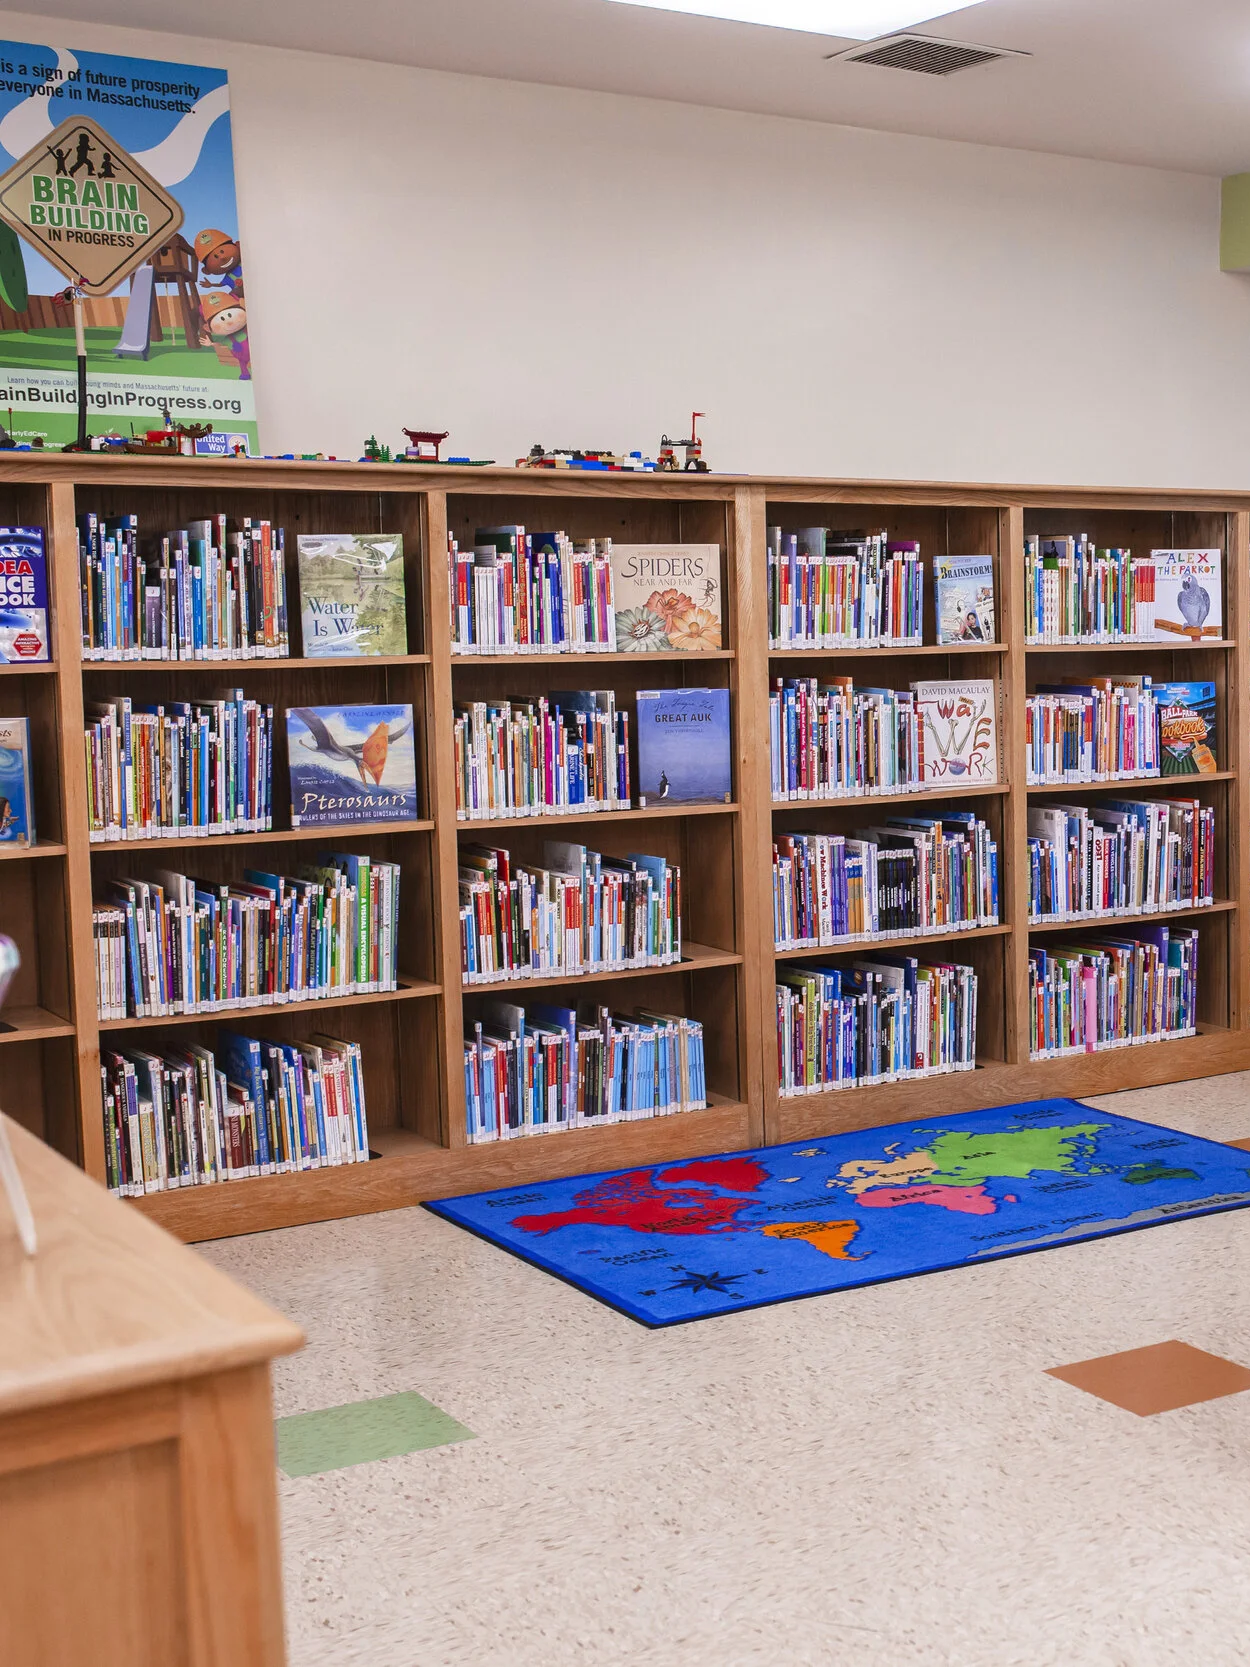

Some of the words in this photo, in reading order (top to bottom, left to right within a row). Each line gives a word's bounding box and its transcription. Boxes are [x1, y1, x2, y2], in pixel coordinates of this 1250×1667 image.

[1, 60, 14, 74] is
[18, 65, 28, 75] a
[32, 64, 63, 82] sign
[67, 70, 82, 83] of
[85, 73, 127, 88] future
[131, 78, 200, 100] prosperity
[69, 85, 82, 100] in
[87, 88, 197, 114] Massachusetts.
[32, 174, 140, 212] BRAIN
[29, 203, 151, 236] BUILDING
[48, 229, 62, 242] IN
[66, 231, 135, 248] PROGRESS
[0, 386, 241, 414] ainBuildngInProgress.org
[208, 443, 226, 453] Way
[1166, 552, 1209, 564] ALEX
[621, 556, 703, 578] SPIDERS
[940, 565, 993, 579] BRAINSTORM!
[1158, 566, 1177, 575] THE
[1179, 565, 1216, 575] PARROT
[306, 597, 358, 615] Water
[313, 620, 328, 636] Is
[948, 687, 990, 695] MACAULAY
[655, 713, 687, 722] GREAT
[691, 713, 711, 721] AUK
[1161, 707, 1183, 720] BALL
[1182, 709, 1198, 717] PARK
[1161, 717, 1206, 737] ookbook
[300, 793, 407, 814] Pterosaurs
[963, 1150, 997, 1160] Asia
[879, 1166, 934, 1179] Europe
[486, 1192, 543, 1205] Arctic
[490, 1196, 548, 1208] Ocean
[766, 1194, 837, 1211] Atlantic
[889, 1188, 943, 1202] Africa
[782, 1201, 839, 1213] Ocean
[1160, 1195, 1244, 1215] Antarctica
[640, 1215, 698, 1229] North
[647, 1215, 726, 1233] America
[773, 1222, 828, 1235] South
[970, 1222, 1050, 1242] Southern
[1051, 1211, 1104, 1226] Ocean
[778, 1222, 854, 1240] America
[600, 1248, 668, 1264] Pacific
[611, 1251, 675, 1266] Ocean
[667, 1264, 688, 1272] N
[728, 1292, 745, 1300] S
